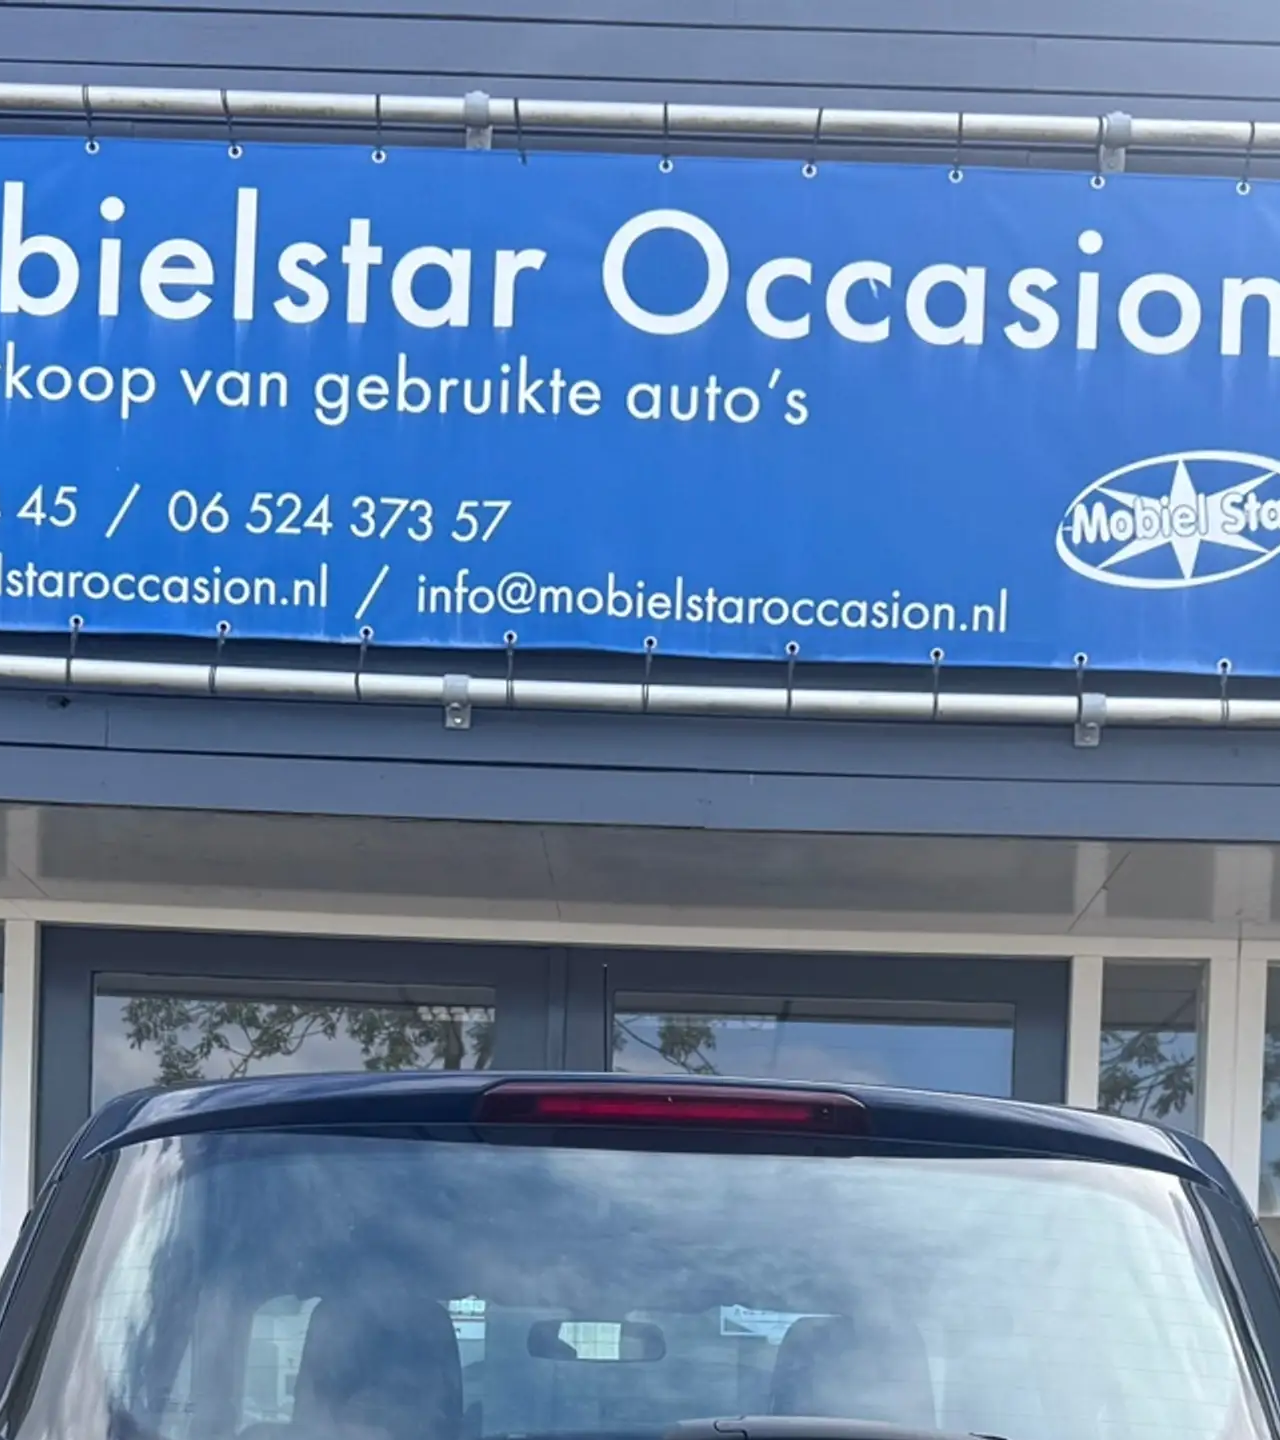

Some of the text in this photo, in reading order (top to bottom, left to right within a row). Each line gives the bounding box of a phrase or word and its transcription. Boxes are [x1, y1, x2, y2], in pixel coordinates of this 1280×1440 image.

[180, 369, 288, 408] van
[314, 352, 601, 426] gebruikte
[626, 367, 809, 426] auto's
[17, 486, 77, 527] 45
[105, 484, 140, 538] /
[168, 490, 229, 534] 06
[246, 493, 333, 536] 524
[350, 496, 433, 542] 373
[451, 500, 512, 542] 57
[1071, 492, 1209, 546] Mobiel
[354, 565, 389, 620] /
[417, 568, 1008, 634] info@mobielstaroccasion.nl
